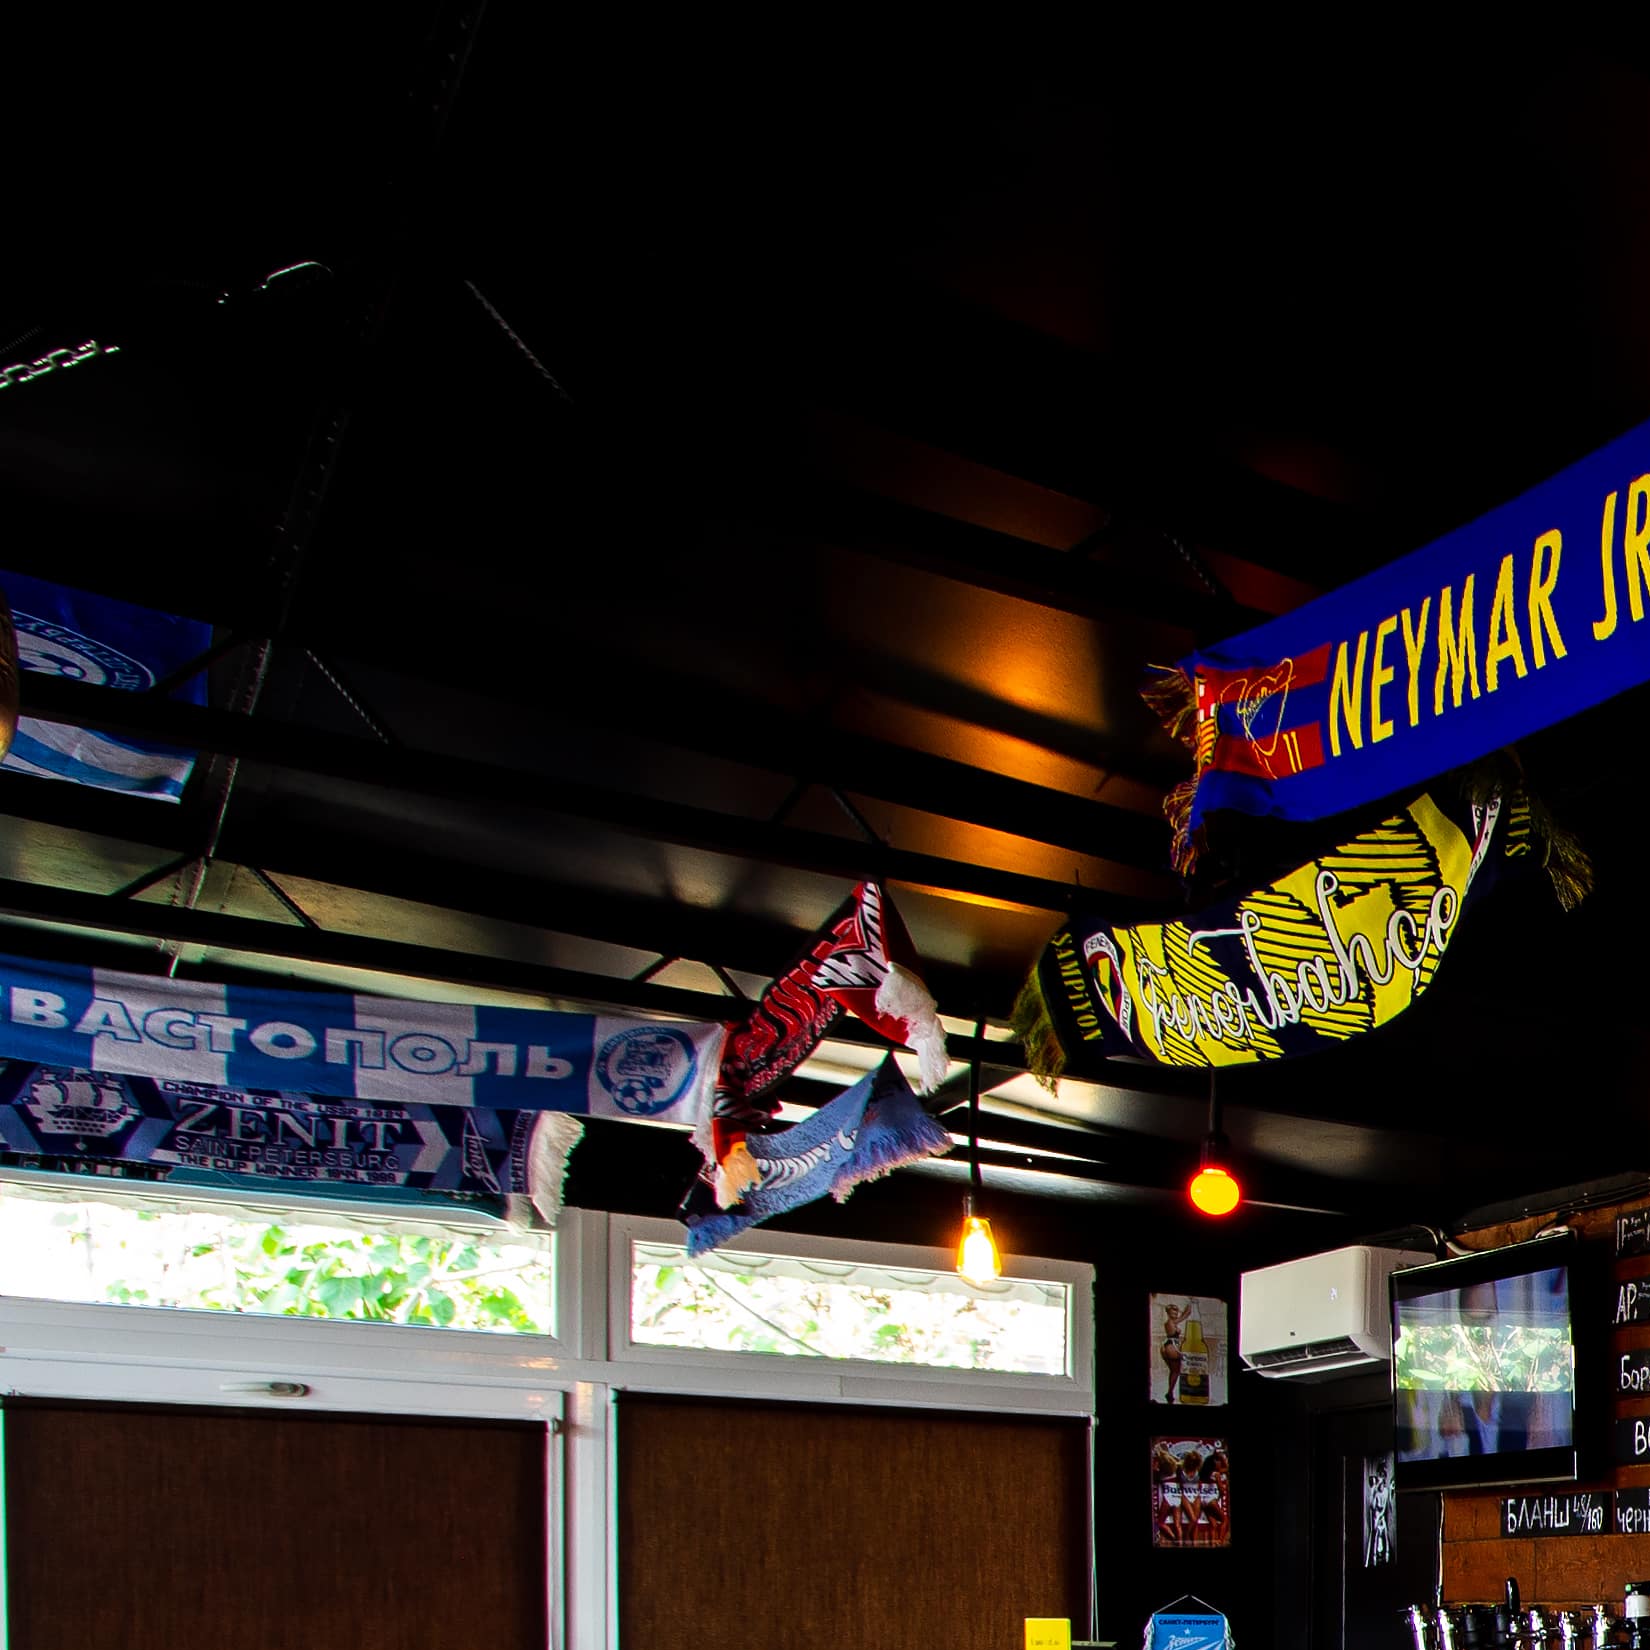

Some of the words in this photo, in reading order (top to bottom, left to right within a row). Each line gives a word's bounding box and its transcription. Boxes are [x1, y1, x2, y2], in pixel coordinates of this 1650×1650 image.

[1328, 528, 1569, 757] NEYMAR
[162, 1079, 247, 1106] CHAMPION
[252, 1091, 274, 1107] OF
[281, 1096, 311, 1113] THE
[317, 1101, 359, 1118] USSR
[173, 1097, 404, 1153] ZENIT
[174, 1134, 402, 1171] SAINT-PETERSBURG
[177, 1151, 209, 1168] THE
[214, 1156, 250, 1171] CUP
[255, 1160, 321, 1178] WINNER
